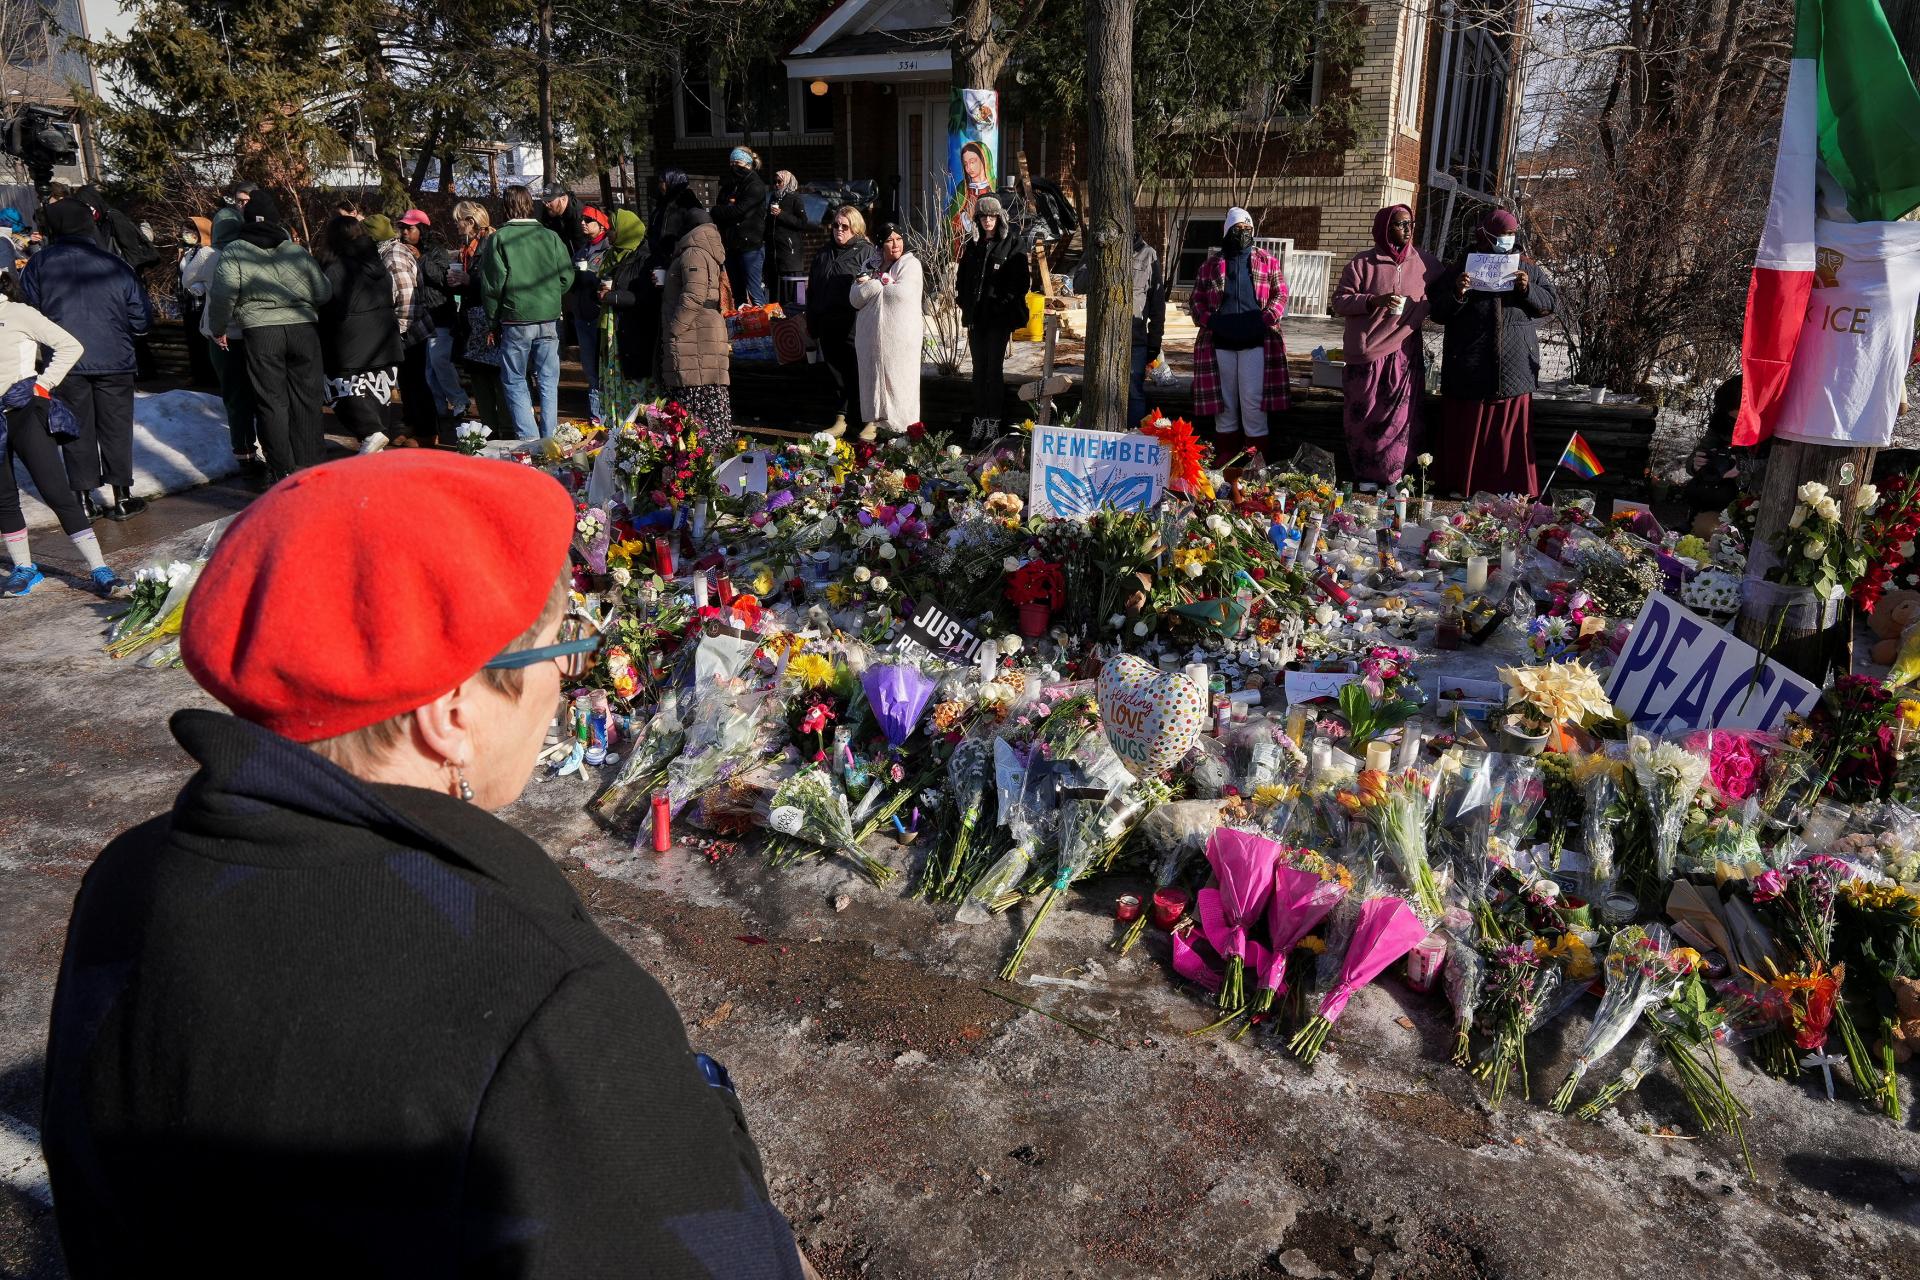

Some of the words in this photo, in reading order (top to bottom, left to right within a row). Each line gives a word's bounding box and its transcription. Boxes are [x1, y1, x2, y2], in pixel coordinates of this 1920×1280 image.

[1822, 305, 1871, 335] ICE
[1042, 434, 1160, 465] REMEMBER
[913, 605, 983, 664] JUSTIC
[1110, 687, 1153, 717] sending
[1110, 701, 1145, 733] LOVE
[1109, 729, 1147, 762] HUGS
[1116, 727, 1136, 739] and
